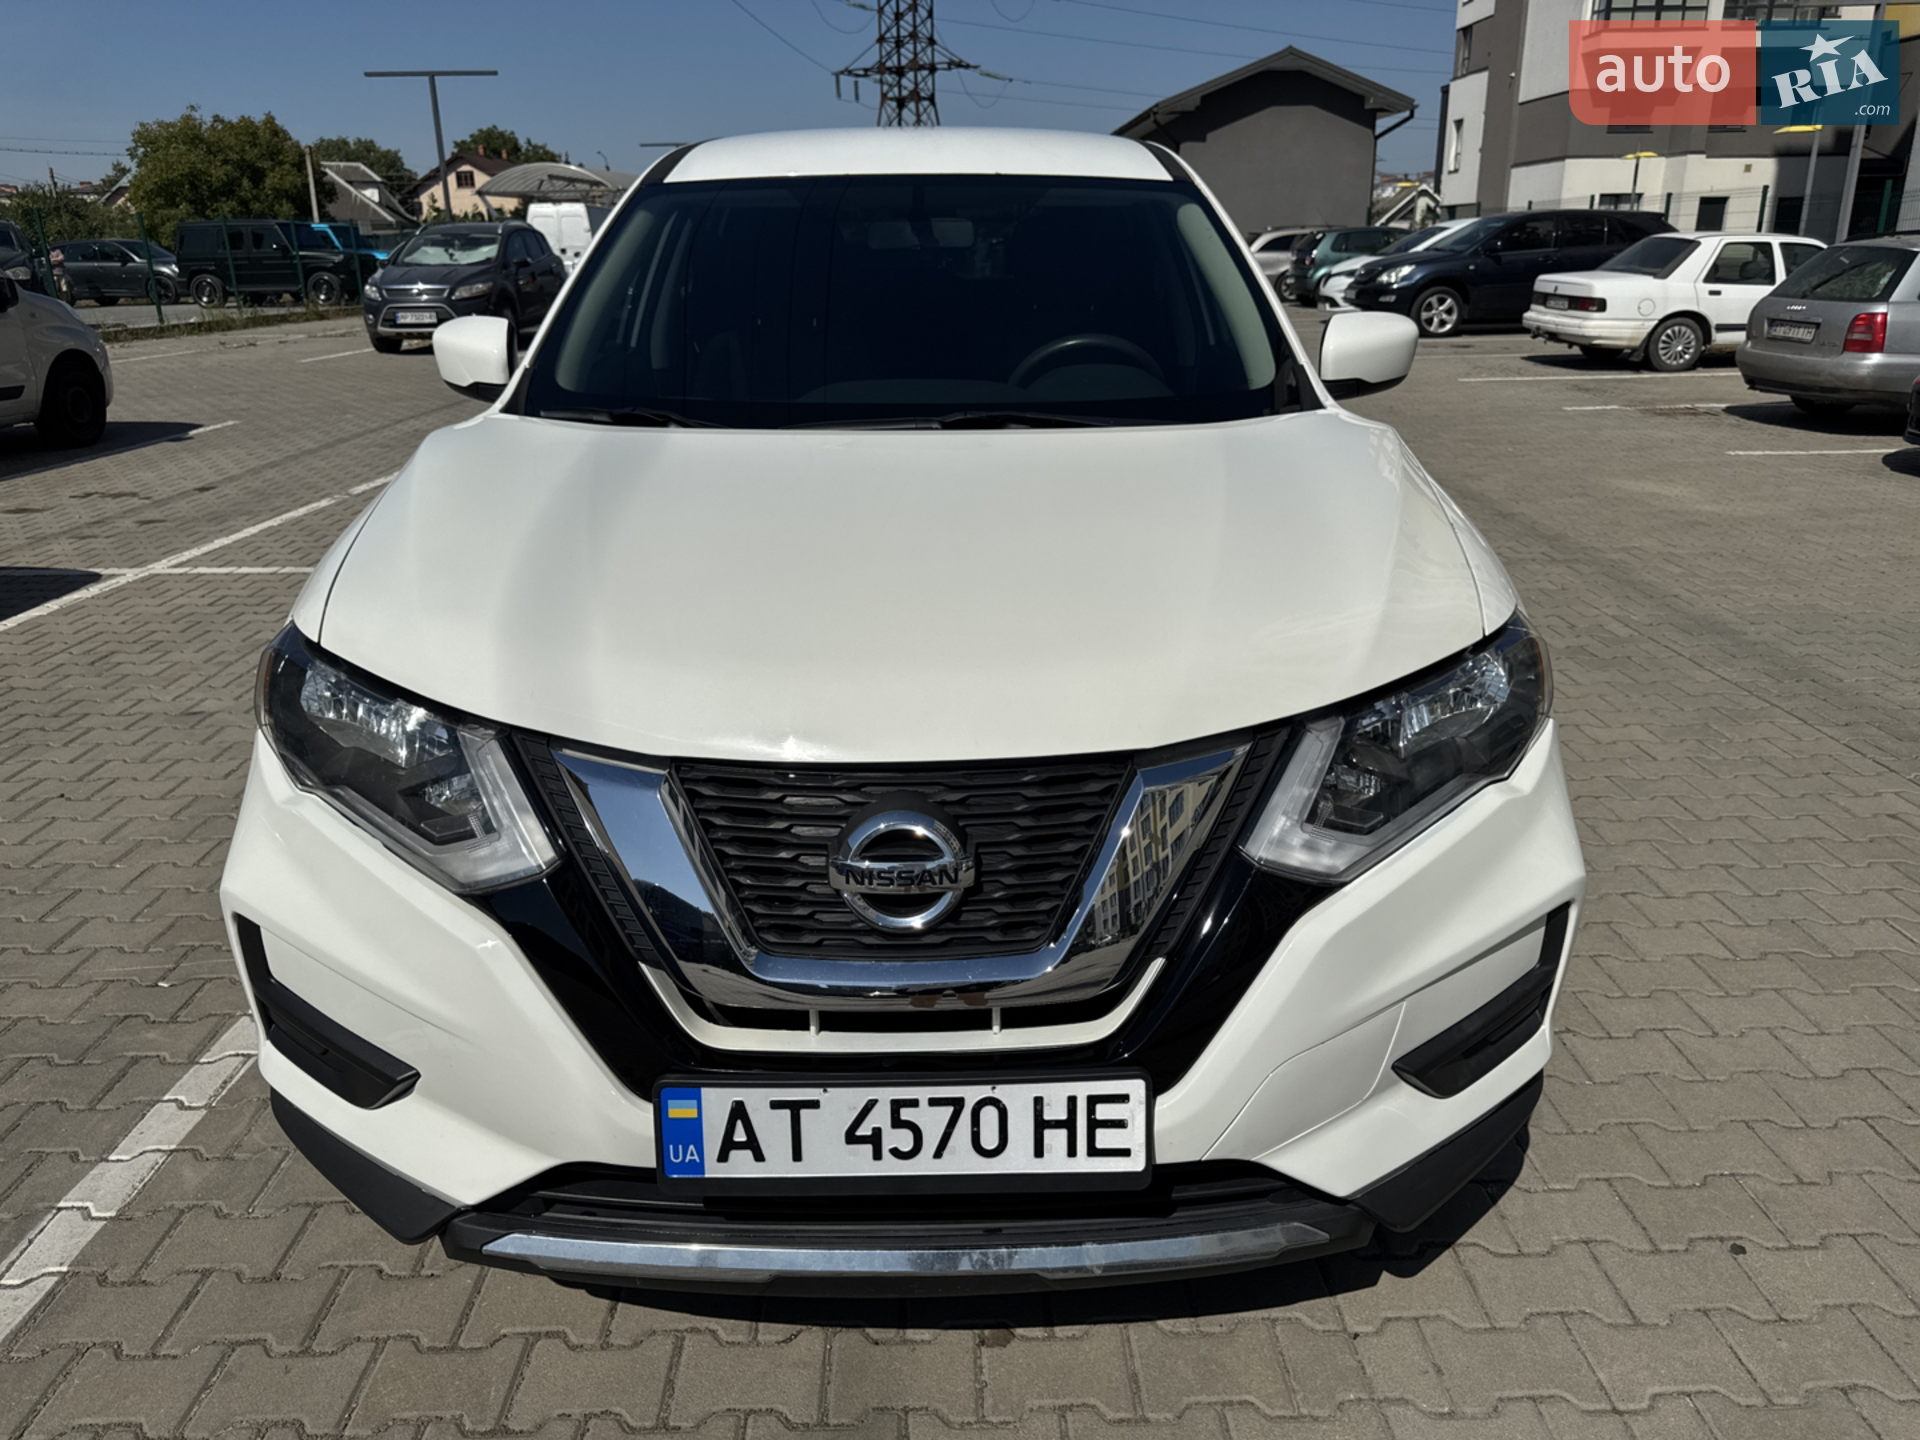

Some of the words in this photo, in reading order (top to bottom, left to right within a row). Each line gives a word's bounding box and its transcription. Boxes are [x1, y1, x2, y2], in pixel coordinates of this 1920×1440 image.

[845, 867, 959, 887] NISSAN
[716, 1098, 821, 1164] AT
[844, 1095, 1009, 1162] 4570
[1033, 1093, 1133, 1159] HE
[669, 1144, 700, 1164] UA
